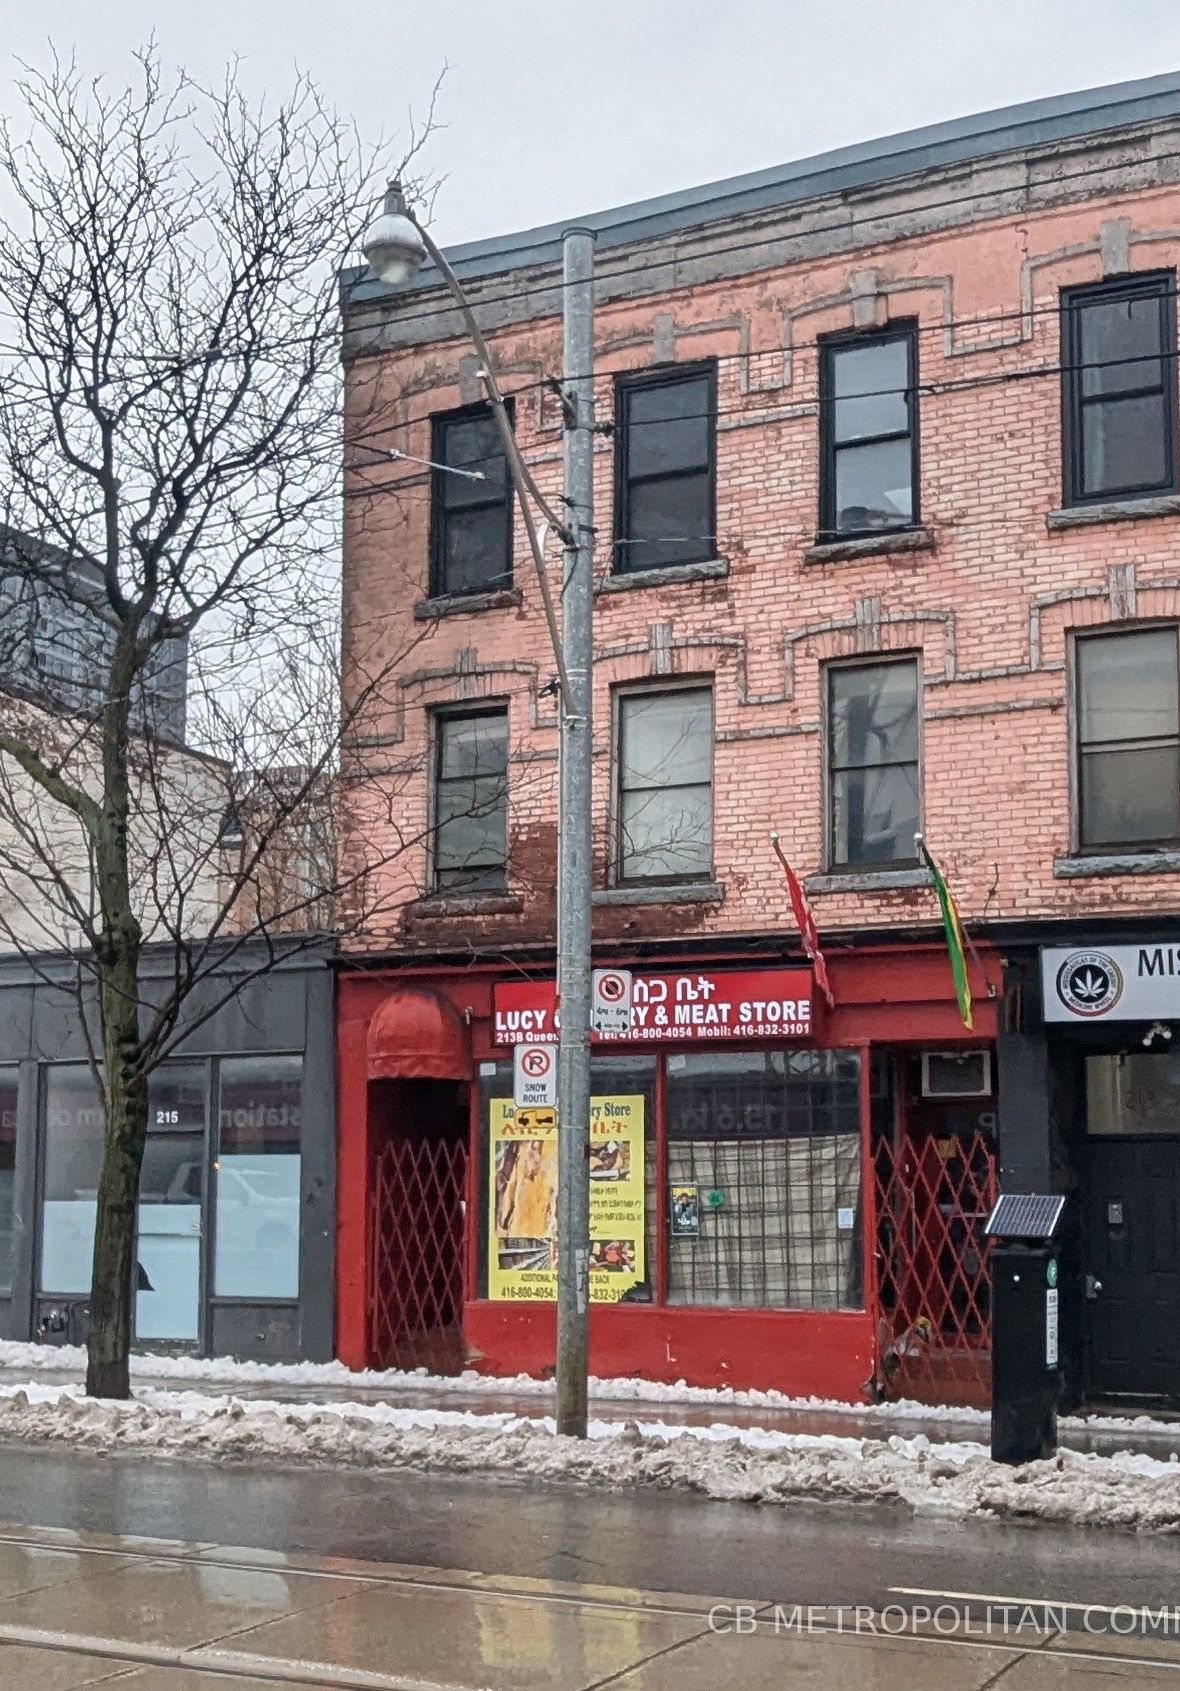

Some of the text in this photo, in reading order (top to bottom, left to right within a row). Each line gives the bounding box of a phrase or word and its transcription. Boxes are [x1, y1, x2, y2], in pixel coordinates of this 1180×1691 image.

[495, 1009, 547, 1031] LUCY
[654, 1005, 668, 1025] &
[675, 1003, 731, 1024] MEAT
[739, 1000, 811, 1022] STORE
[496, 1032, 523, 1043] 213B
[698, 1025, 731, 1037] Mobil:
[733, 1023, 810, 1036] 416-832-3101
[525, 1083, 547, 1092] SNOW
[523, 1094, 548, 1103] ROUTE
[604, 1102, 631, 1117] Store
[156, 1111, 178, 1124] 215
